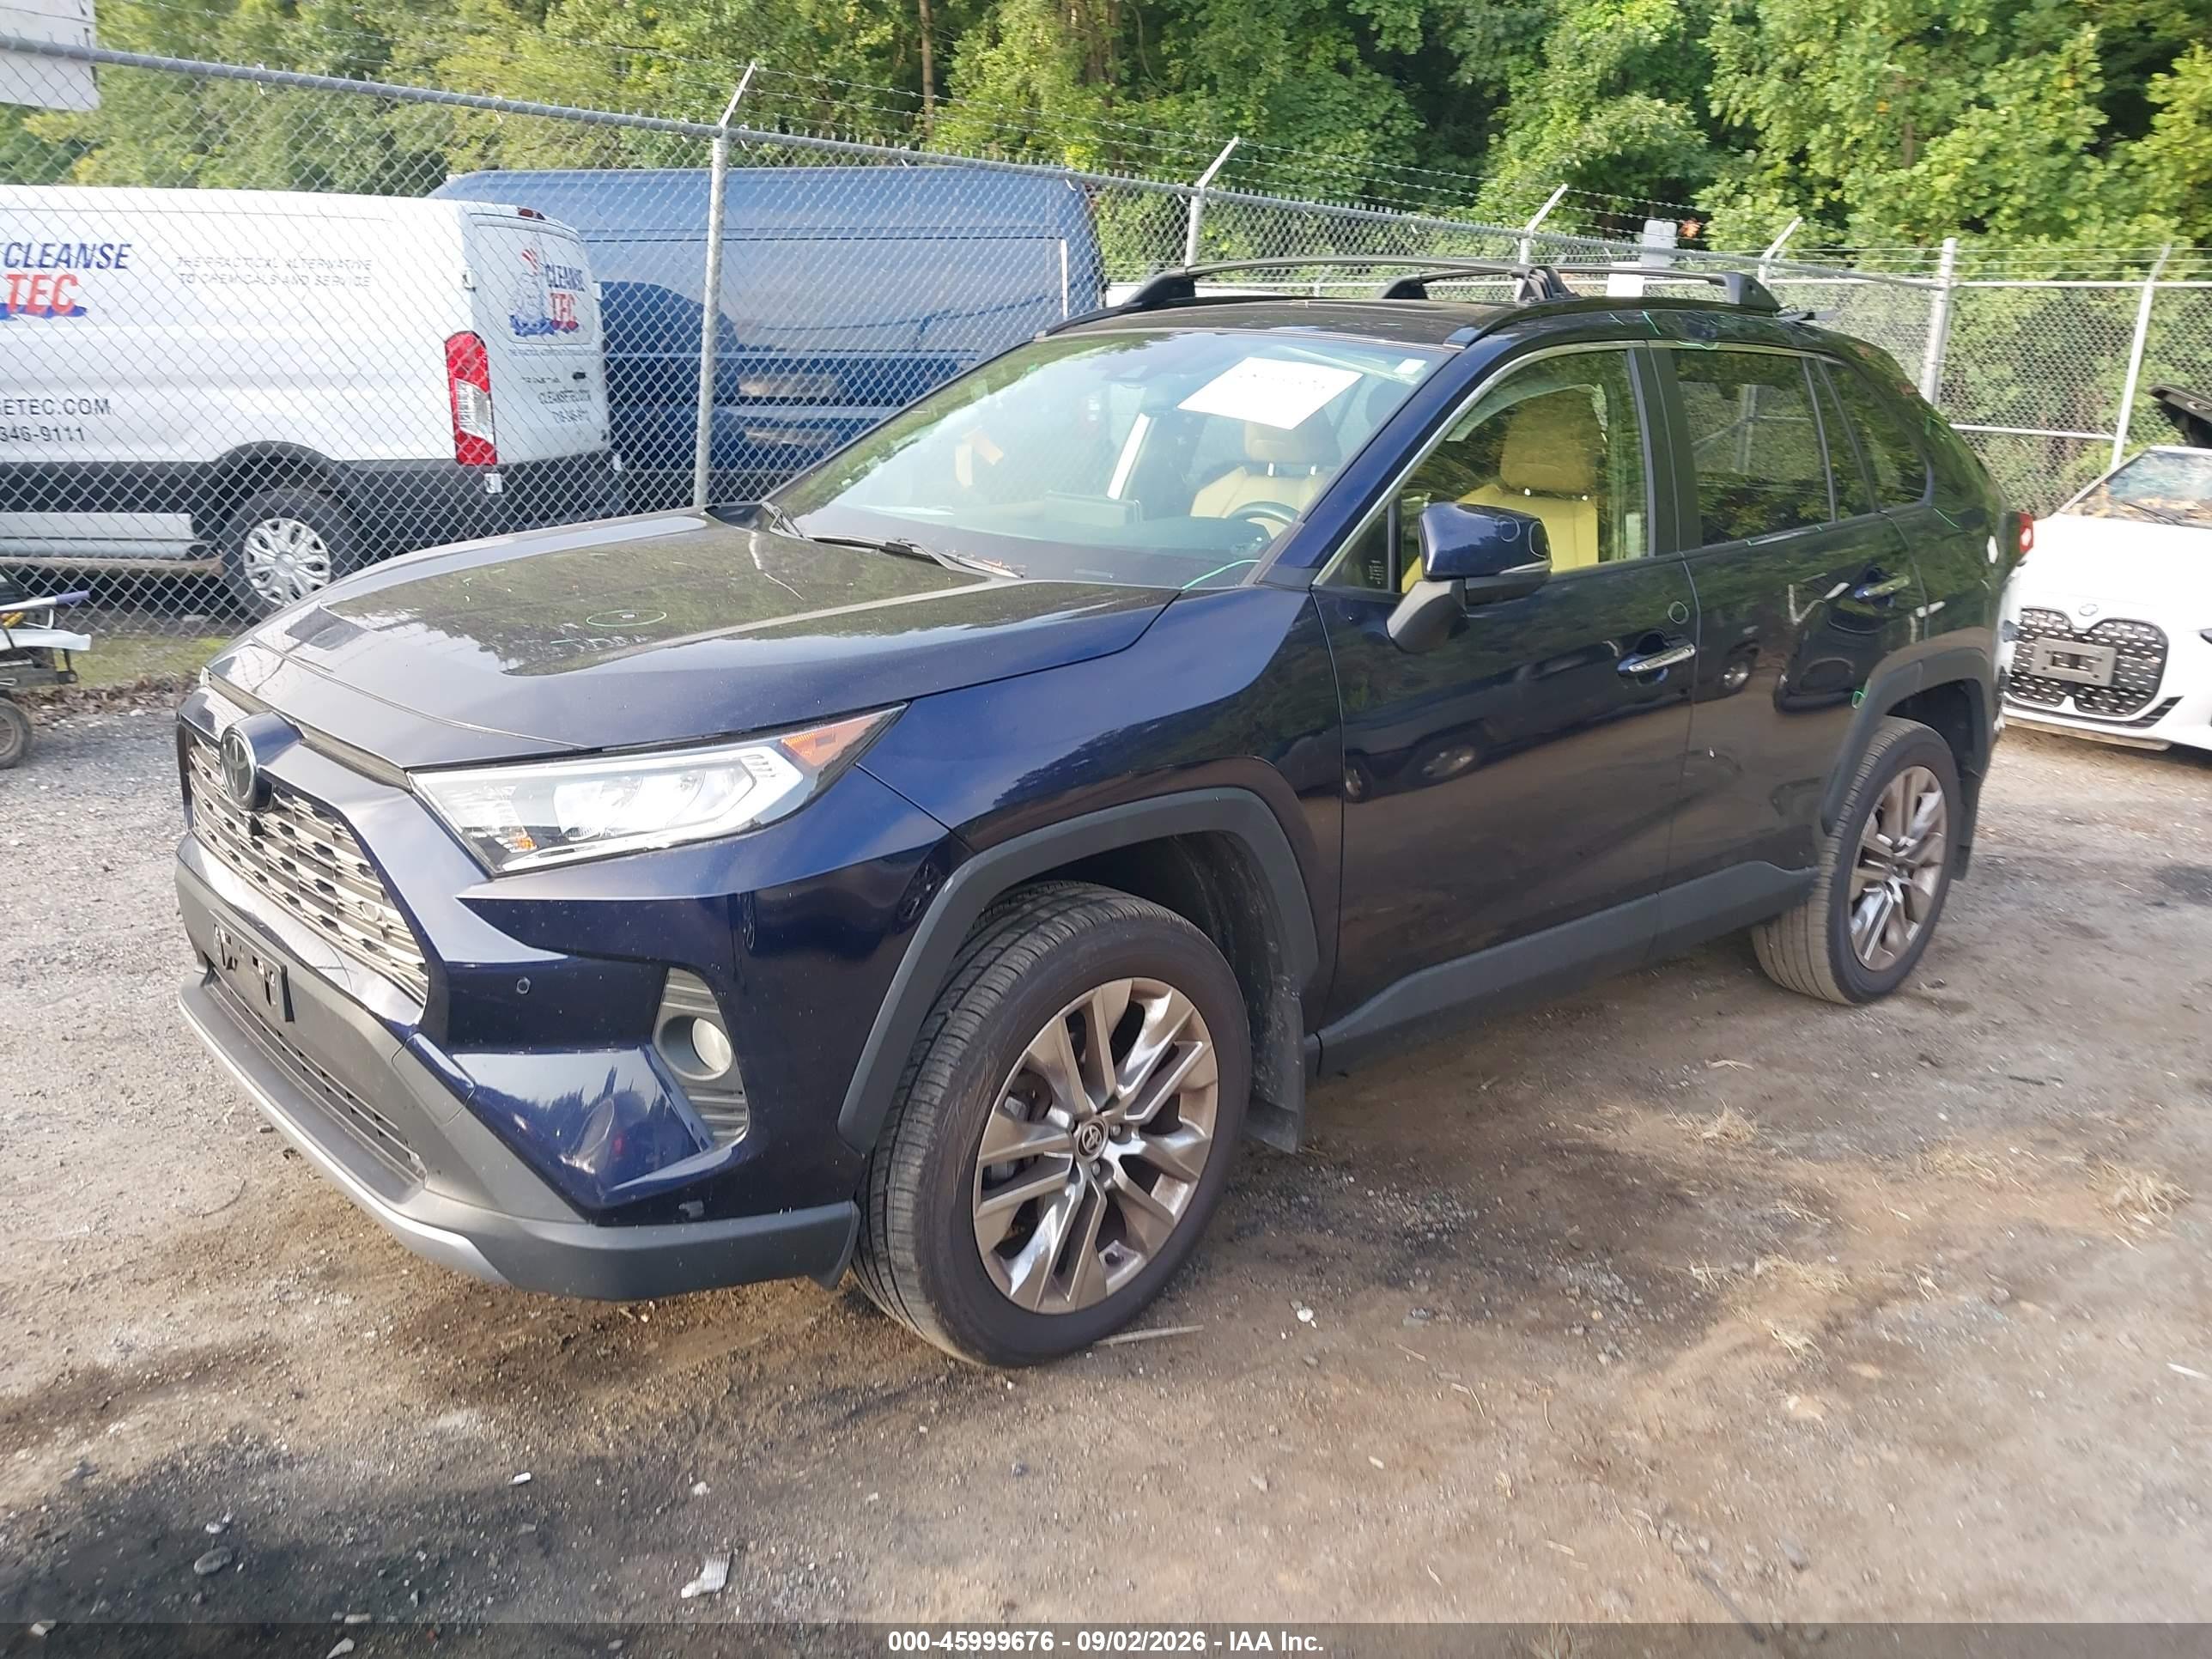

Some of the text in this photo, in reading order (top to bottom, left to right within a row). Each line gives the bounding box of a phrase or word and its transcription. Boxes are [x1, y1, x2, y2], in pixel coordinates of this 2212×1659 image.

[4, 241, 133, 270] CLEANSE
[6, 273, 79, 314] TEC
[0, 398, 112, 416] ETEC.COM
